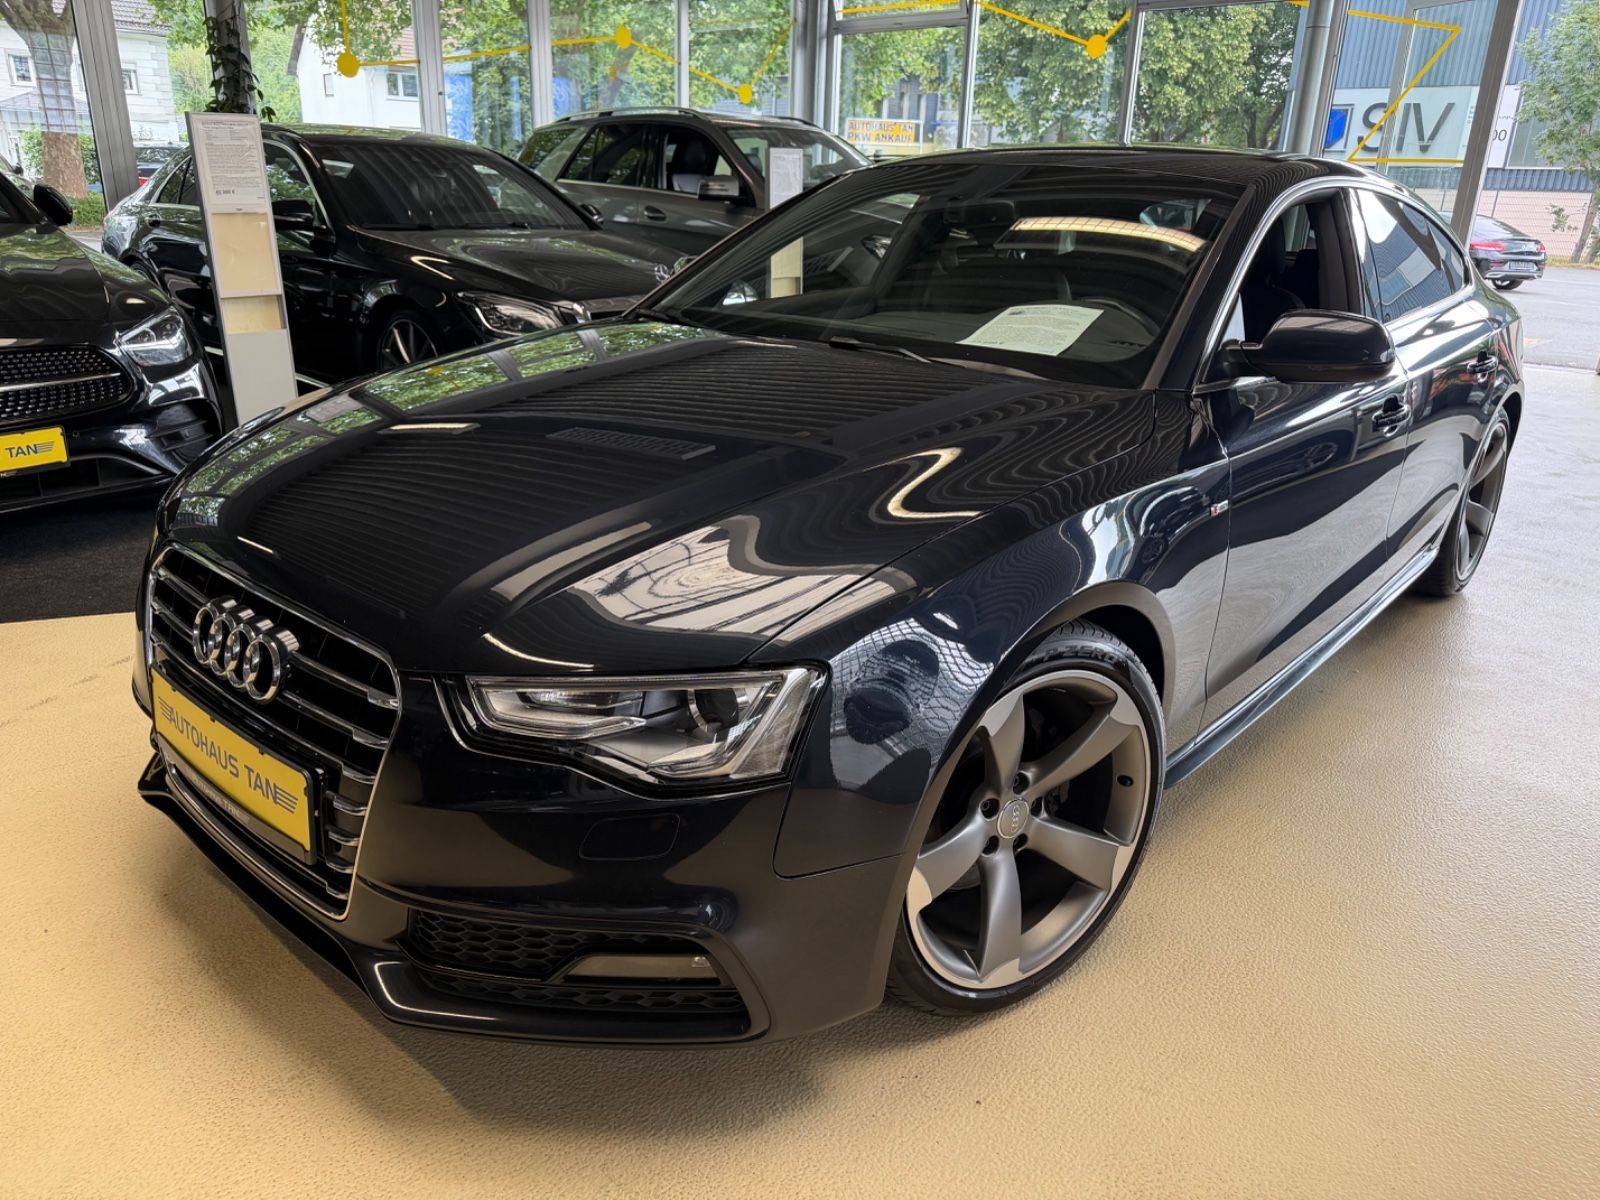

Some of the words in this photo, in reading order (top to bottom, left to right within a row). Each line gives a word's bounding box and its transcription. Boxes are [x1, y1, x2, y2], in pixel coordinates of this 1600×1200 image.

[1357, 102, 1456, 153] SIV
[848, 132, 872, 142] PKW
[875, 133, 913, 143] ANKAUF
[5, 444, 38, 459] TAN
[1063, 645, 1119, 663] ZERO
[169, 707, 240, 779] AUTOHAUS
[244, 763, 279, 805] TAN
